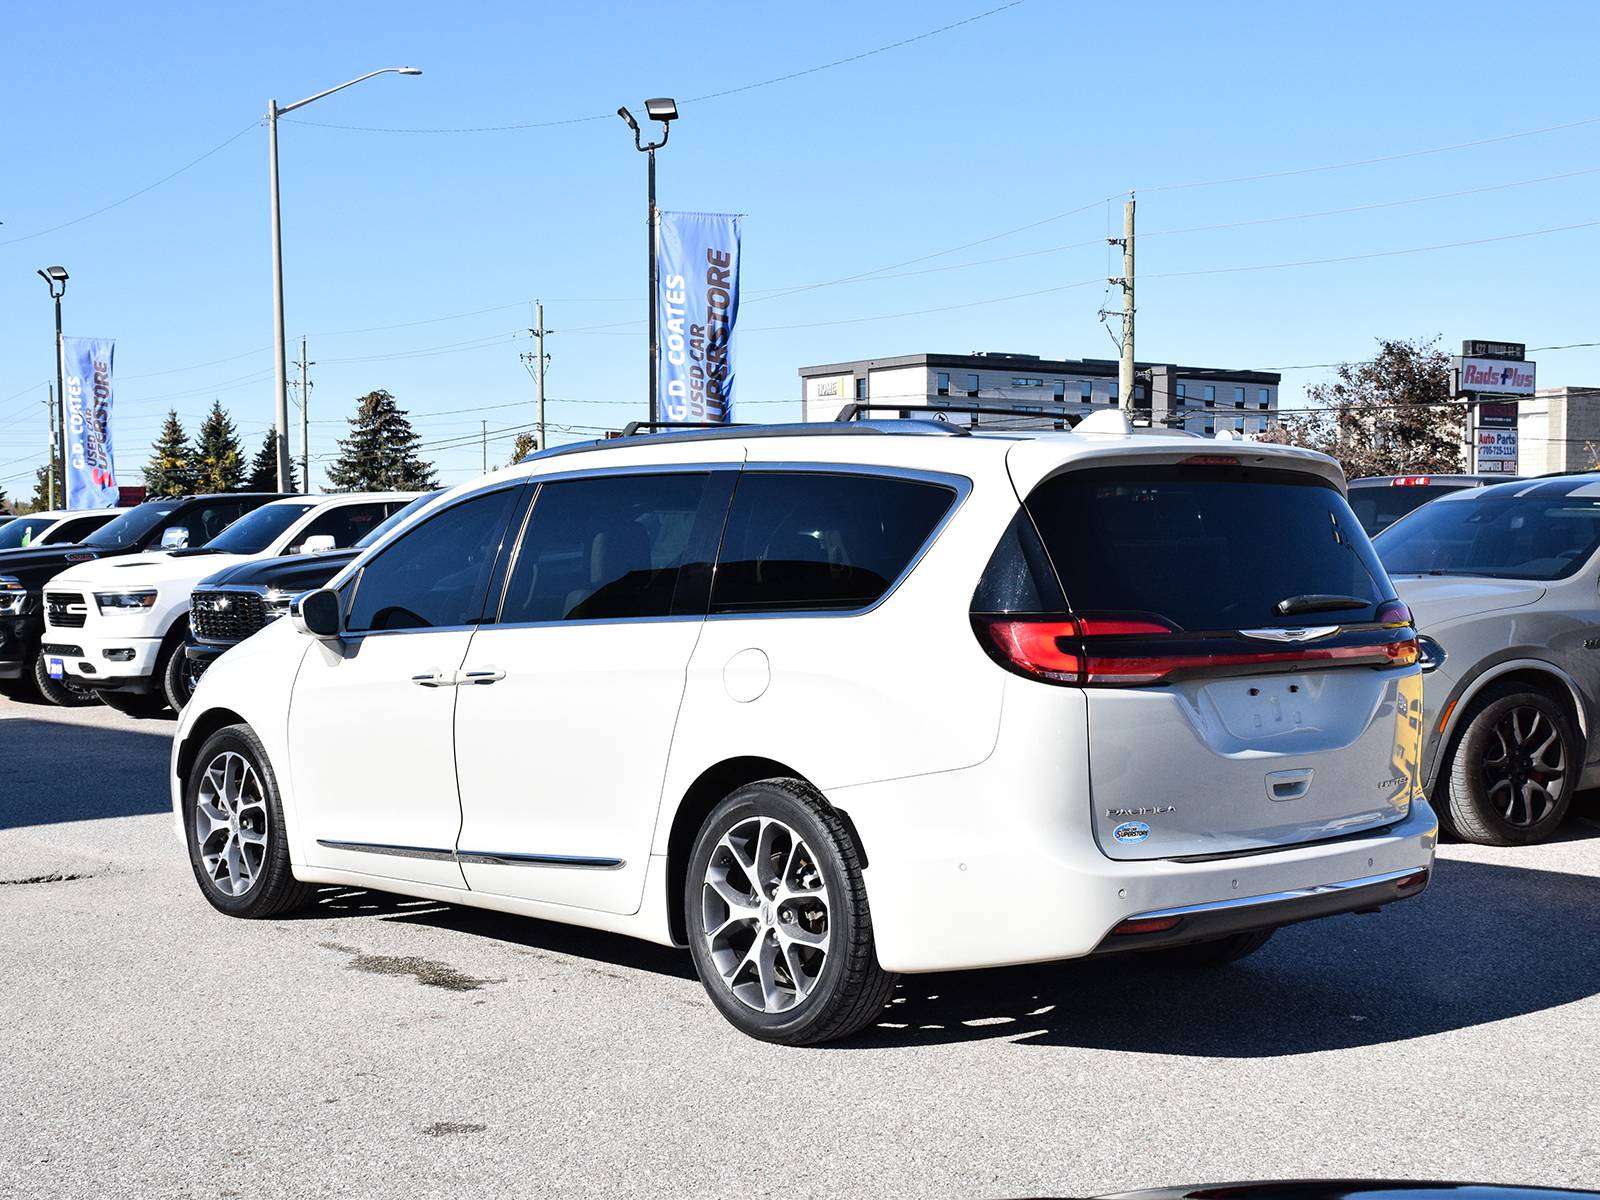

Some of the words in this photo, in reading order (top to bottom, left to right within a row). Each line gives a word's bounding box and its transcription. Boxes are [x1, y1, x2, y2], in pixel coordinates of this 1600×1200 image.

[666, 273, 687, 366] COATES
[706, 248, 731, 424] UPERSTORE
[689, 323, 705, 362] CAR
[690, 366, 705, 418] USED
[1464, 364, 1500, 386] Rads
[1500, 367, 1534, 387] Plus
[68, 375, 83, 434] COATES
[85, 407, 94, 432] CAR
[92, 360, 113, 488] SUPERSTORE
[87, 434, 97, 467] USED
[1479, 433, 1495, 444] Auto
[1496, 433, 1516, 445] Parts
[1105, 805, 1177, 817] PACIFICA
